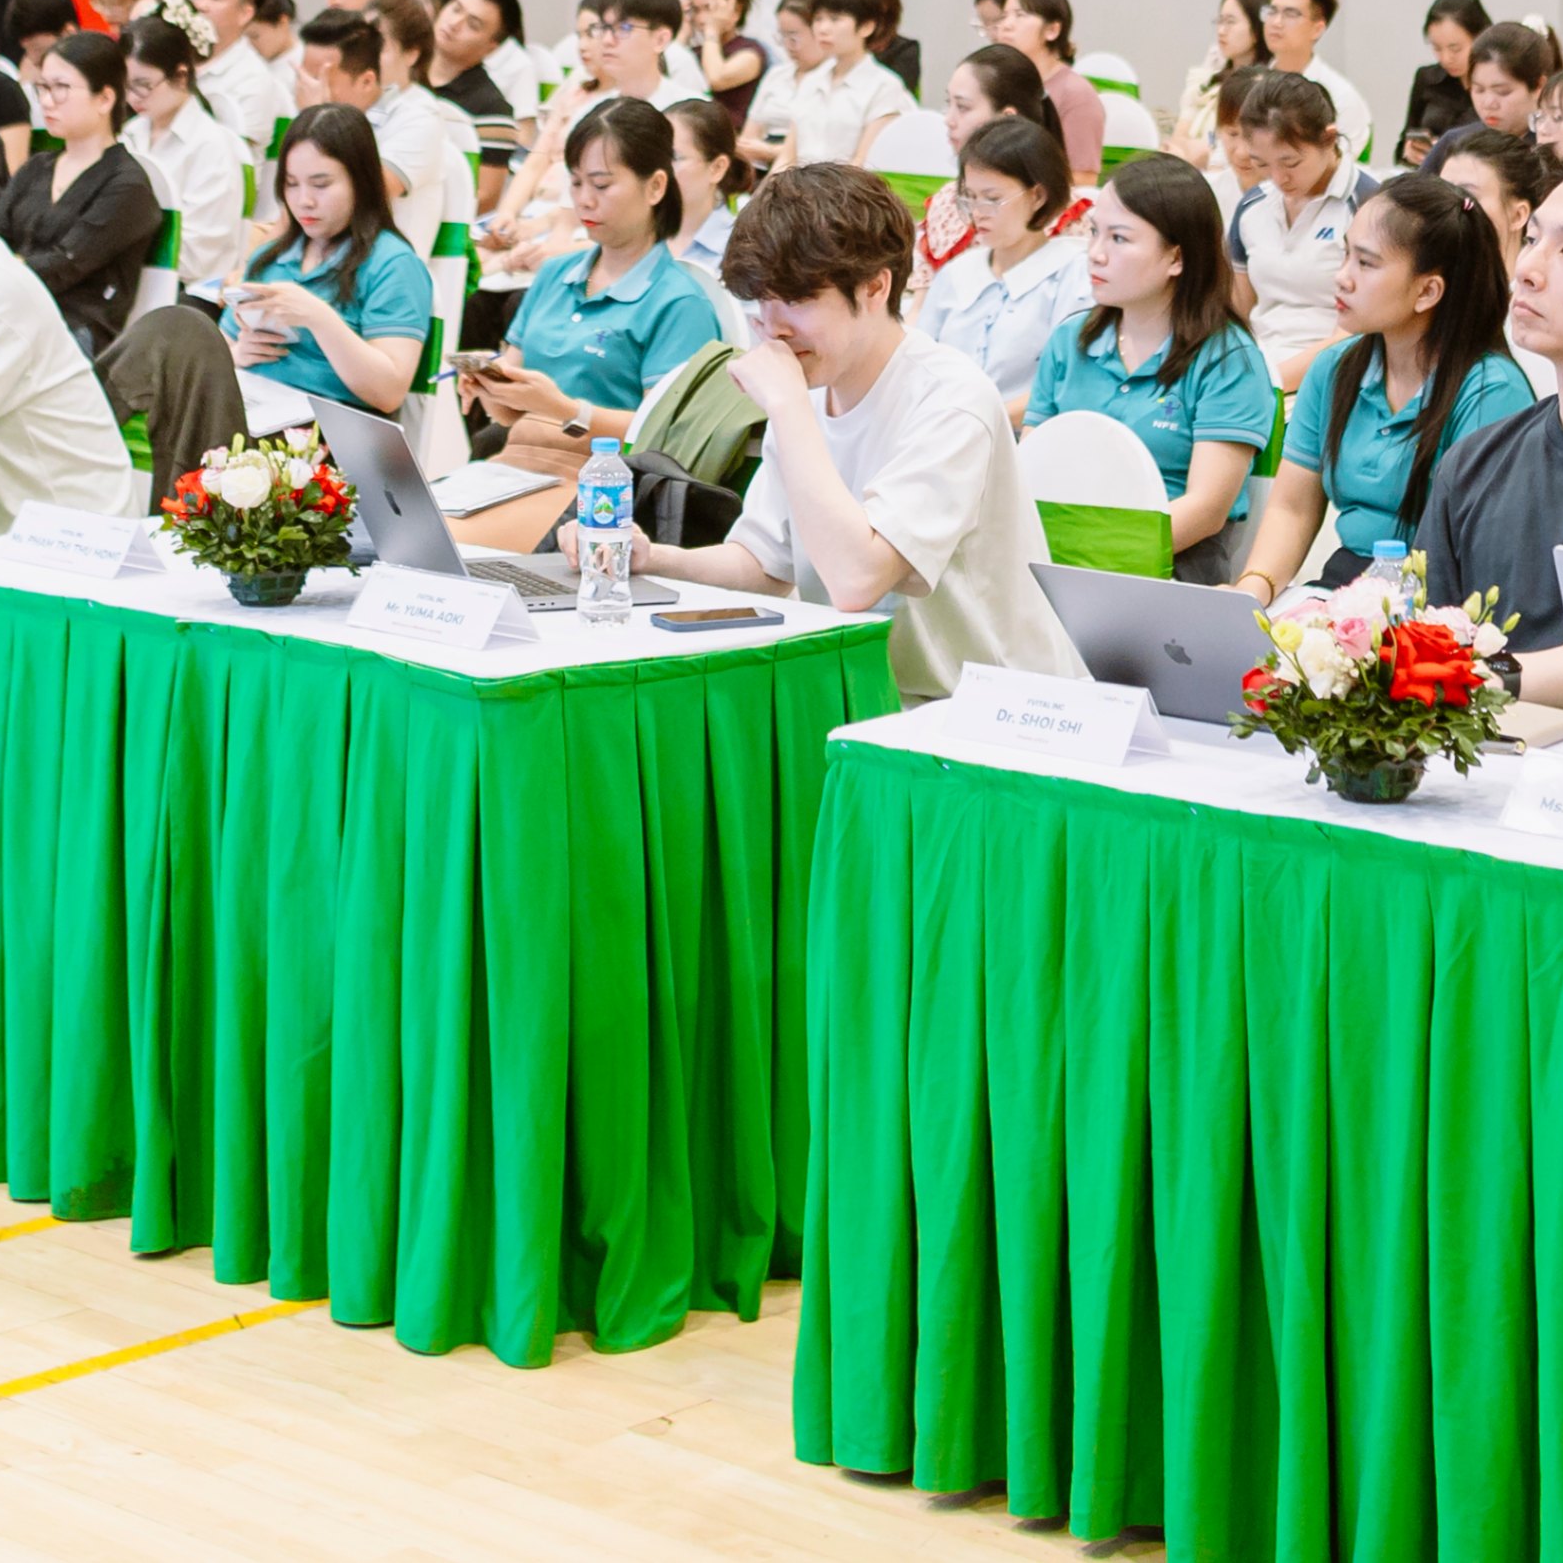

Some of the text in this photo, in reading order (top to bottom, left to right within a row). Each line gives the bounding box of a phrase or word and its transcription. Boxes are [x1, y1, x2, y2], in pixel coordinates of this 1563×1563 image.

[385, 602, 465, 625] Mr. YUMA AOKI
[996, 708, 1083, 735] Dr. SHOI SHI
